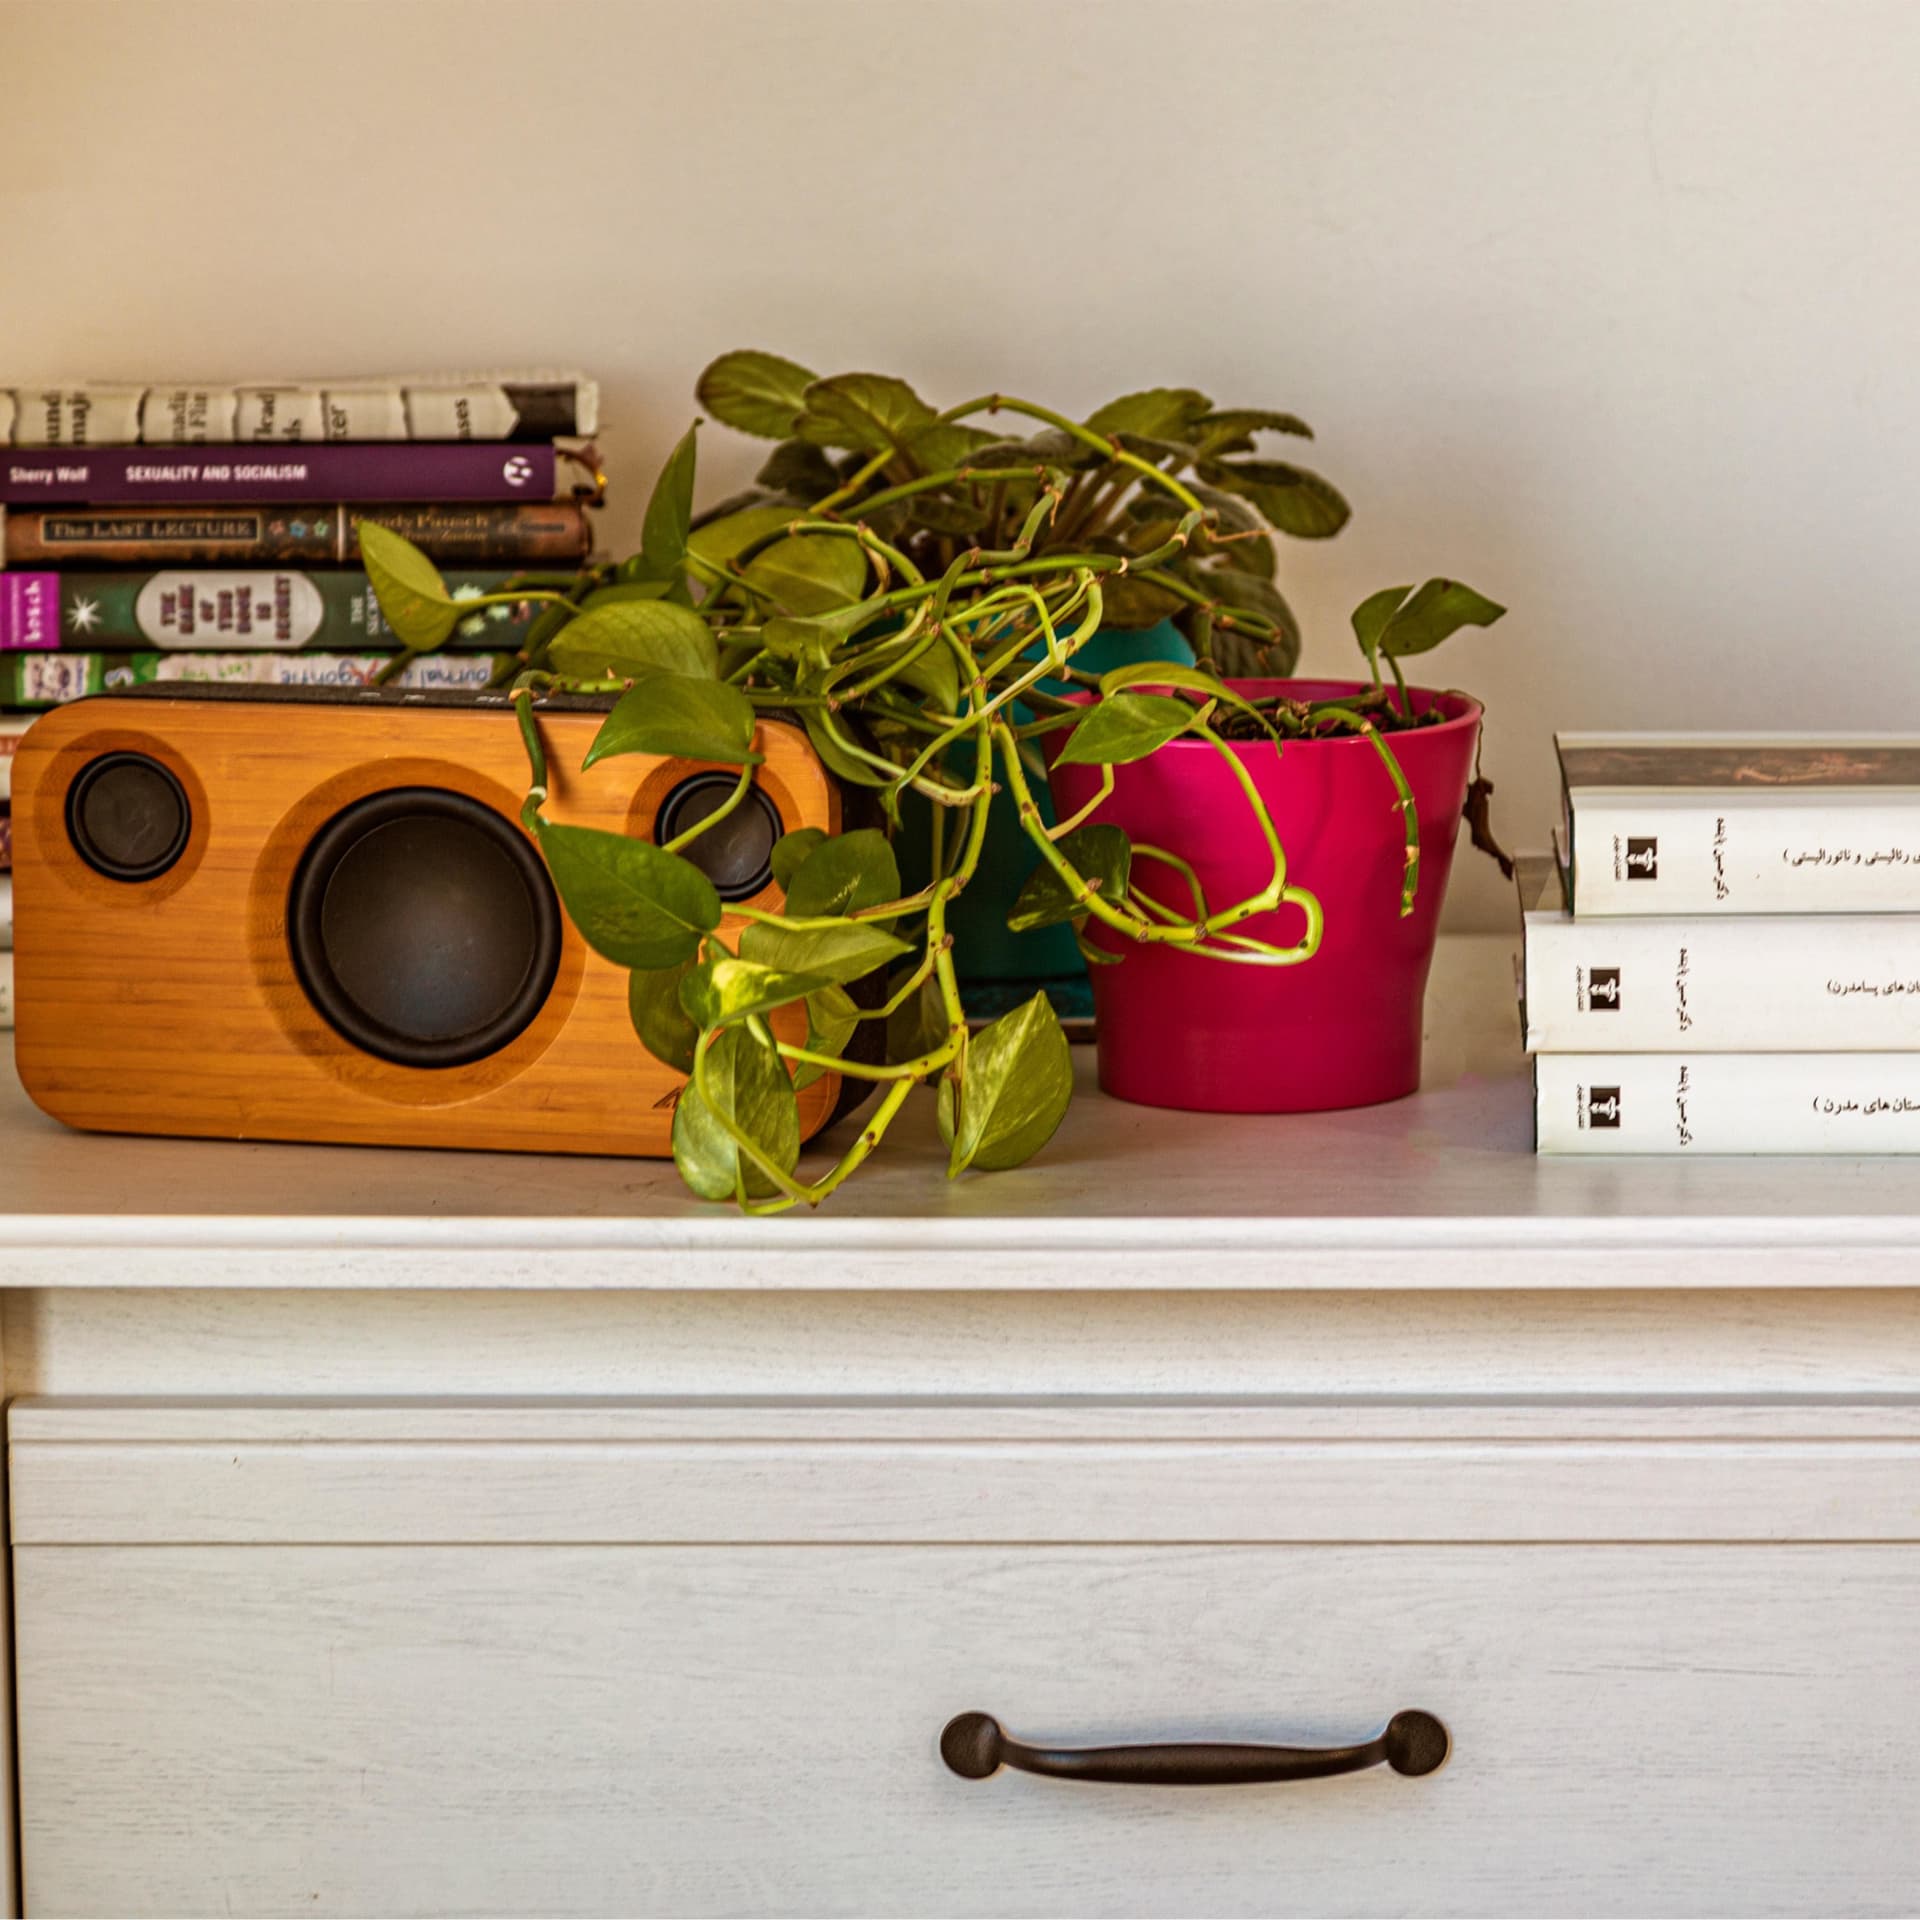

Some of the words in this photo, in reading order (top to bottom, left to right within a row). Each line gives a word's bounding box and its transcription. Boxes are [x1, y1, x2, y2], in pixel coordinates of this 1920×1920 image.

[10, 467, 53, 485] Sherry
[56, 466, 89, 482] Wolf
[125, 465, 198, 482] SEXUALITY
[202, 465, 230, 481] AND
[234, 464, 308, 481] SOCIALISM
[53, 521, 89, 538] The
[92, 521, 147, 538] LAST
[151, 520, 251, 538] LECTURE
[160, 592, 176, 626] THE
[217, 590, 233, 630] THIS
[236, 586, 252, 634] BOOK
[274, 575, 291, 640] SECRET
[421, 667, 489, 685] ournal
